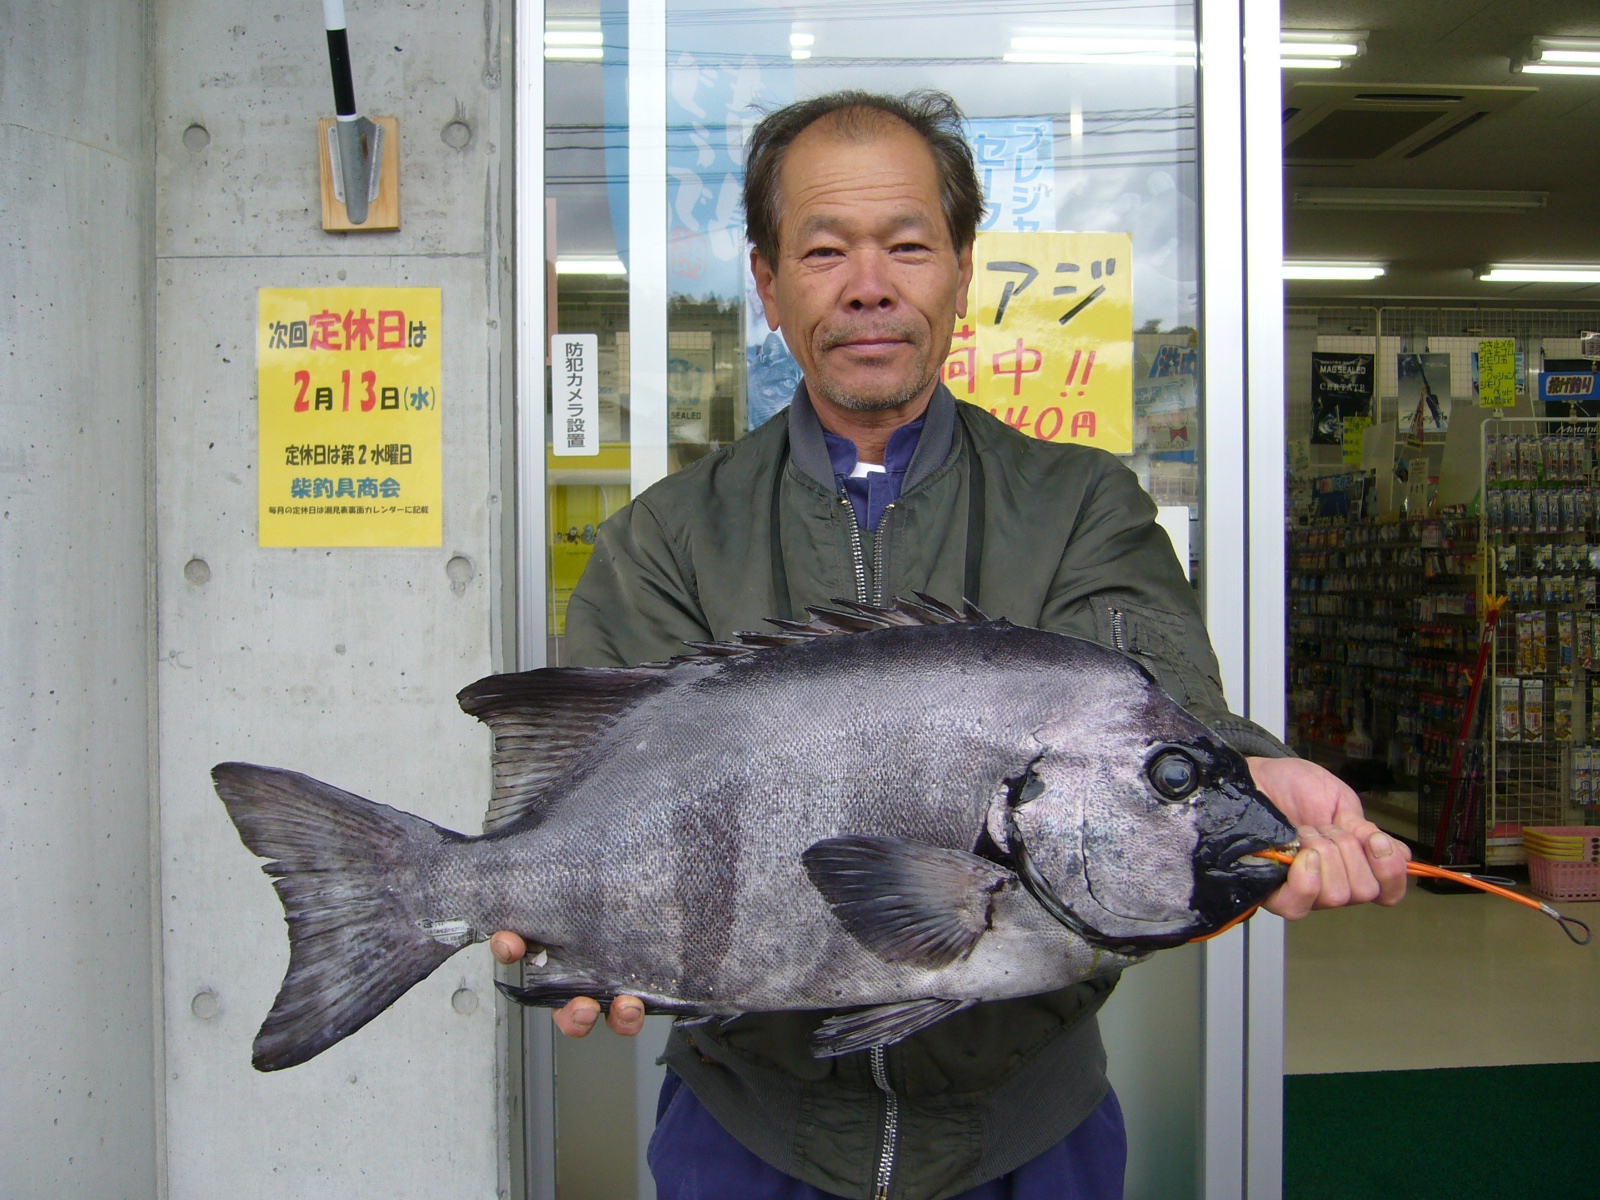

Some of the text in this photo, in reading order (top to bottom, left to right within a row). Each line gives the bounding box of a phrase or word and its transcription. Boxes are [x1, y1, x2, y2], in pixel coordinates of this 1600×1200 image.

[986, 258, 1116, 326] アジ
[269, 308, 427, 351] 次回定休日は
[1320, 365, 1366, 374] MAGSEALED
[565, 342, 585, 448] 防犯カメラ設置
[285, 444, 412, 466] 定休日は第2水曜日
[291, 477, 401, 499] 柴釣具商会
